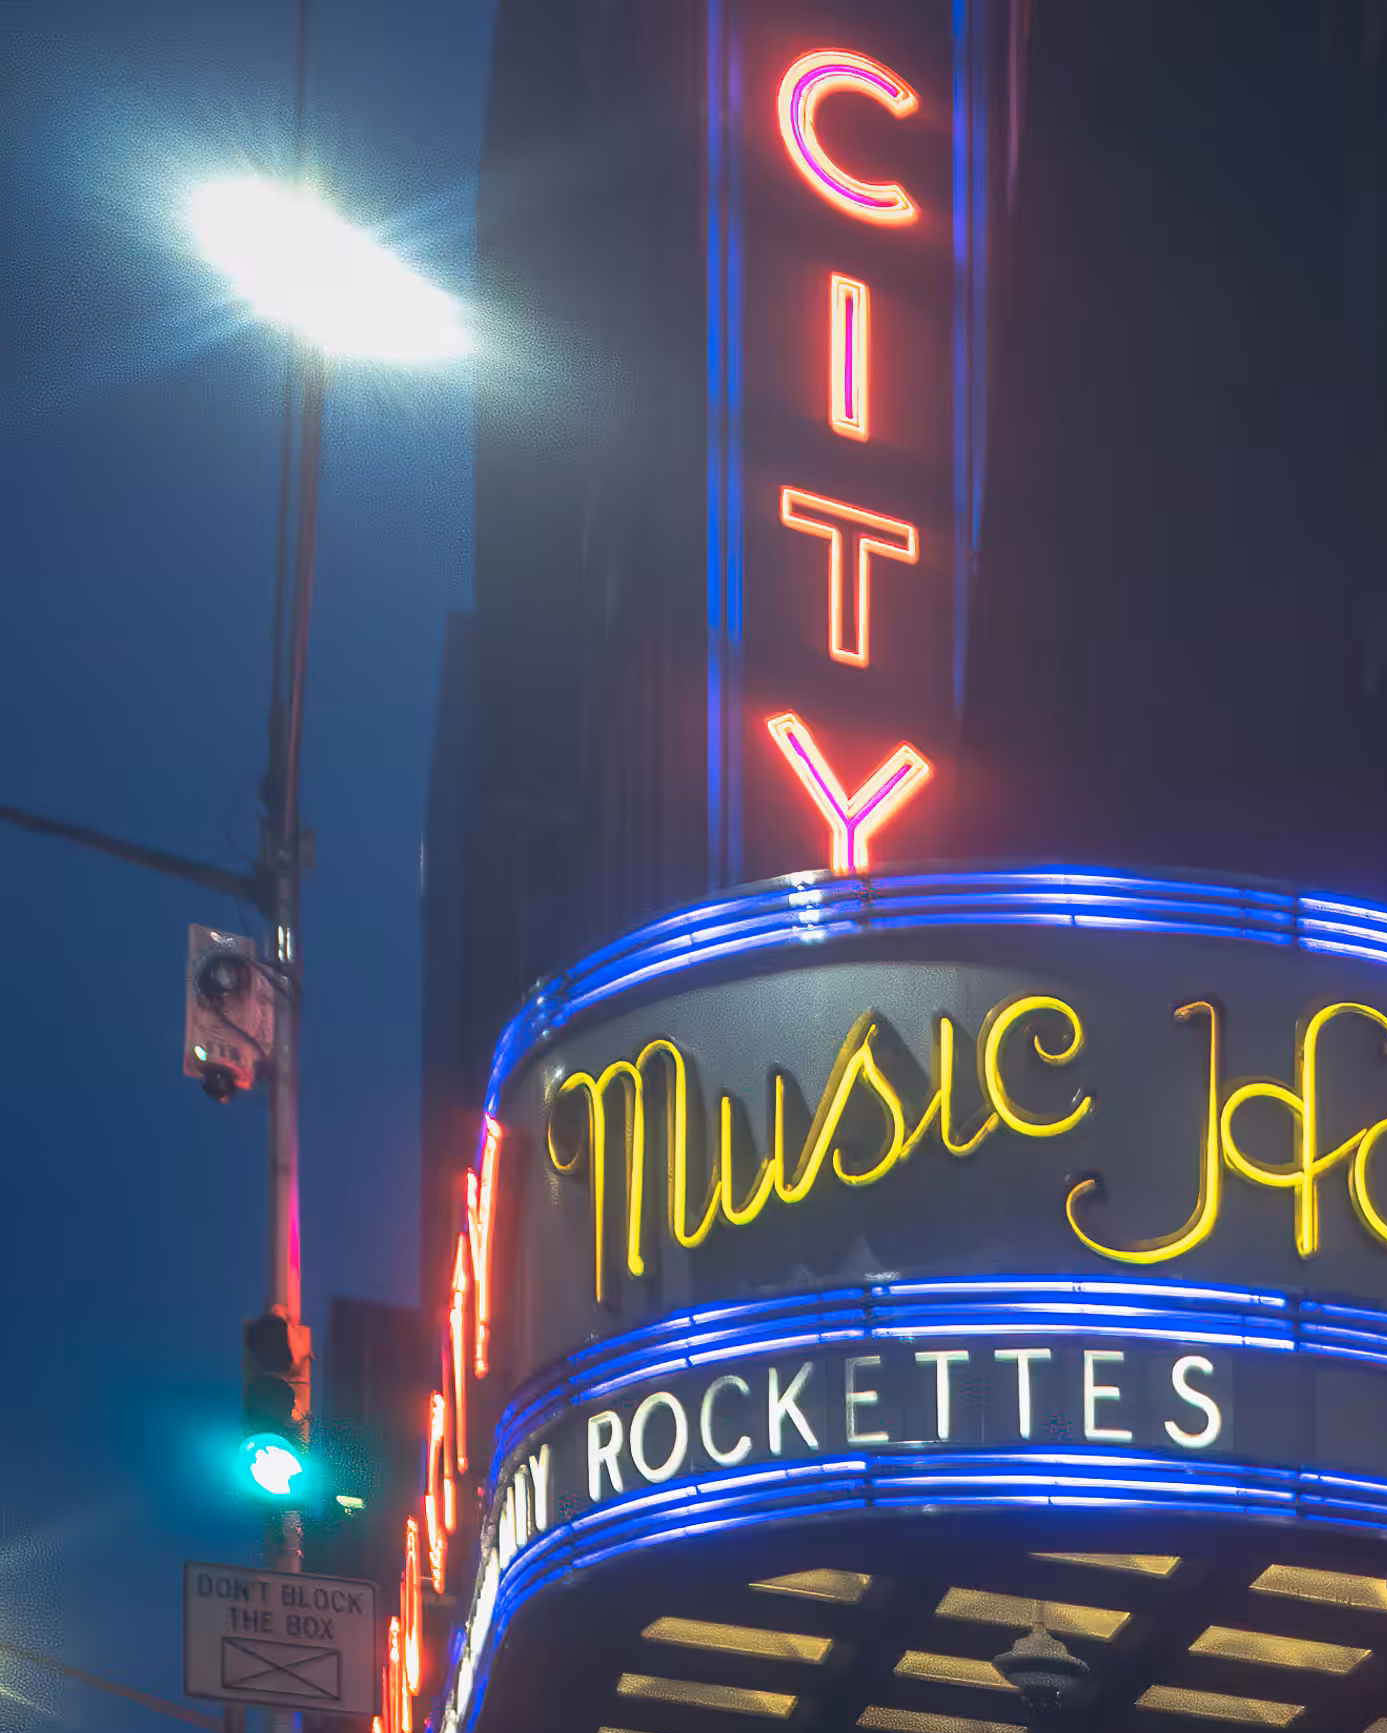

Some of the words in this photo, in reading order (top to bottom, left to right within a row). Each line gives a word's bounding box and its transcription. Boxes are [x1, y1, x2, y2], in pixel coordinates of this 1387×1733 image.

[778, 48, 932, 874] CITY
[547, 996, 1095, 1303] Music
[587, 1348, 1222, 1503] ROCKETTES
[197, 1573, 270, 1603] DON'T
[281, 1584, 363, 1614] BLOCK
[229, 1606, 273, 1633] THE
[286, 1614, 334, 1640] BOX
